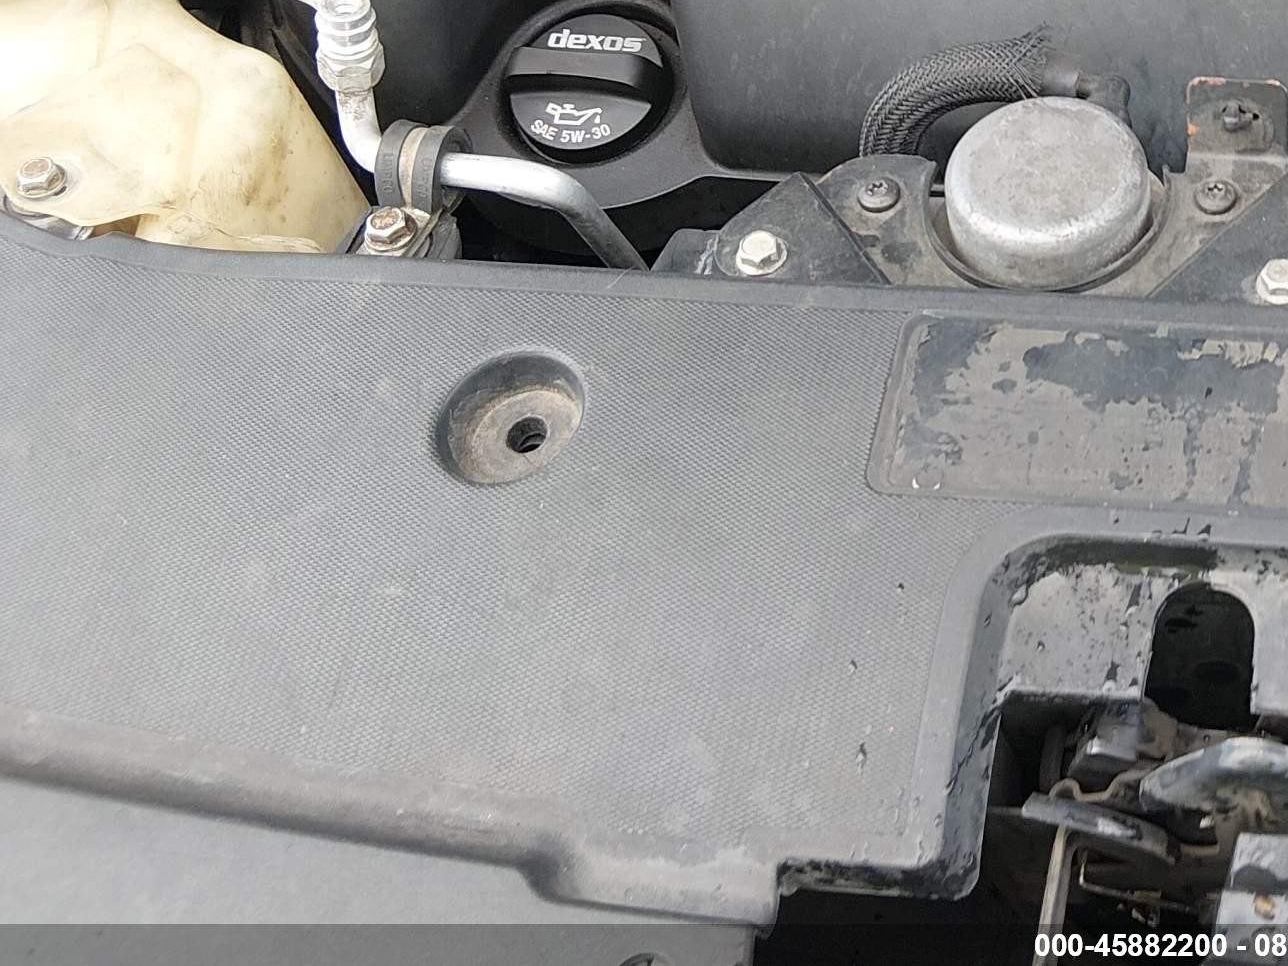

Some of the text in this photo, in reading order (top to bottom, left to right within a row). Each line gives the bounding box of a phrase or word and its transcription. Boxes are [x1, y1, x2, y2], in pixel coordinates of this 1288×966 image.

[547, 29, 643, 52] dexos
[530, 119, 611, 143] SAE 5W-30
